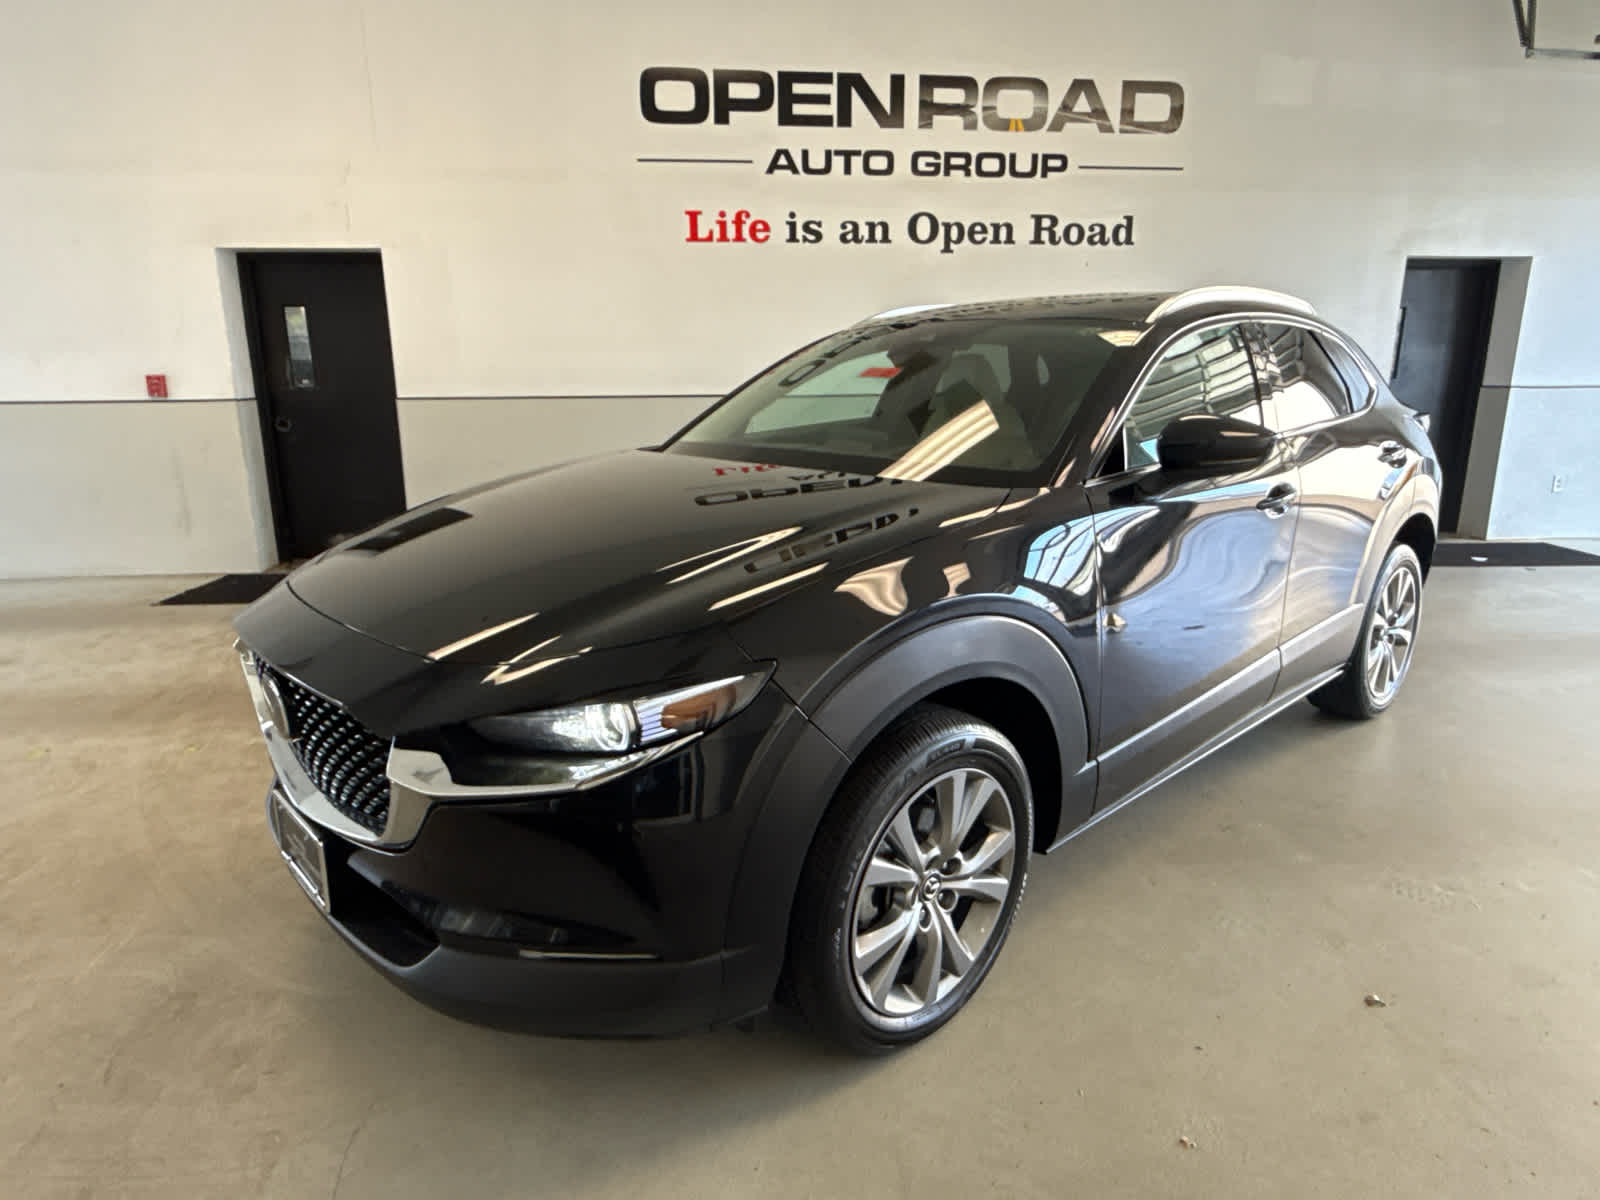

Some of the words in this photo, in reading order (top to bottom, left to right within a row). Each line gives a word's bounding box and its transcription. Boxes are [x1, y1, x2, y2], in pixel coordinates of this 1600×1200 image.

[639, 66, 906, 129] OPEN
[917, 74, 1185, 135] ROAD
[765, 148, 895, 176] AUTO
[910, 150, 1069, 179] GROUP
[684, 210, 771, 244] Life
[785, 211, 824, 244] is
[839, 220, 892, 245] an
[907, 211, 1016, 254] Open
[1029, 213, 1135, 247] Road
